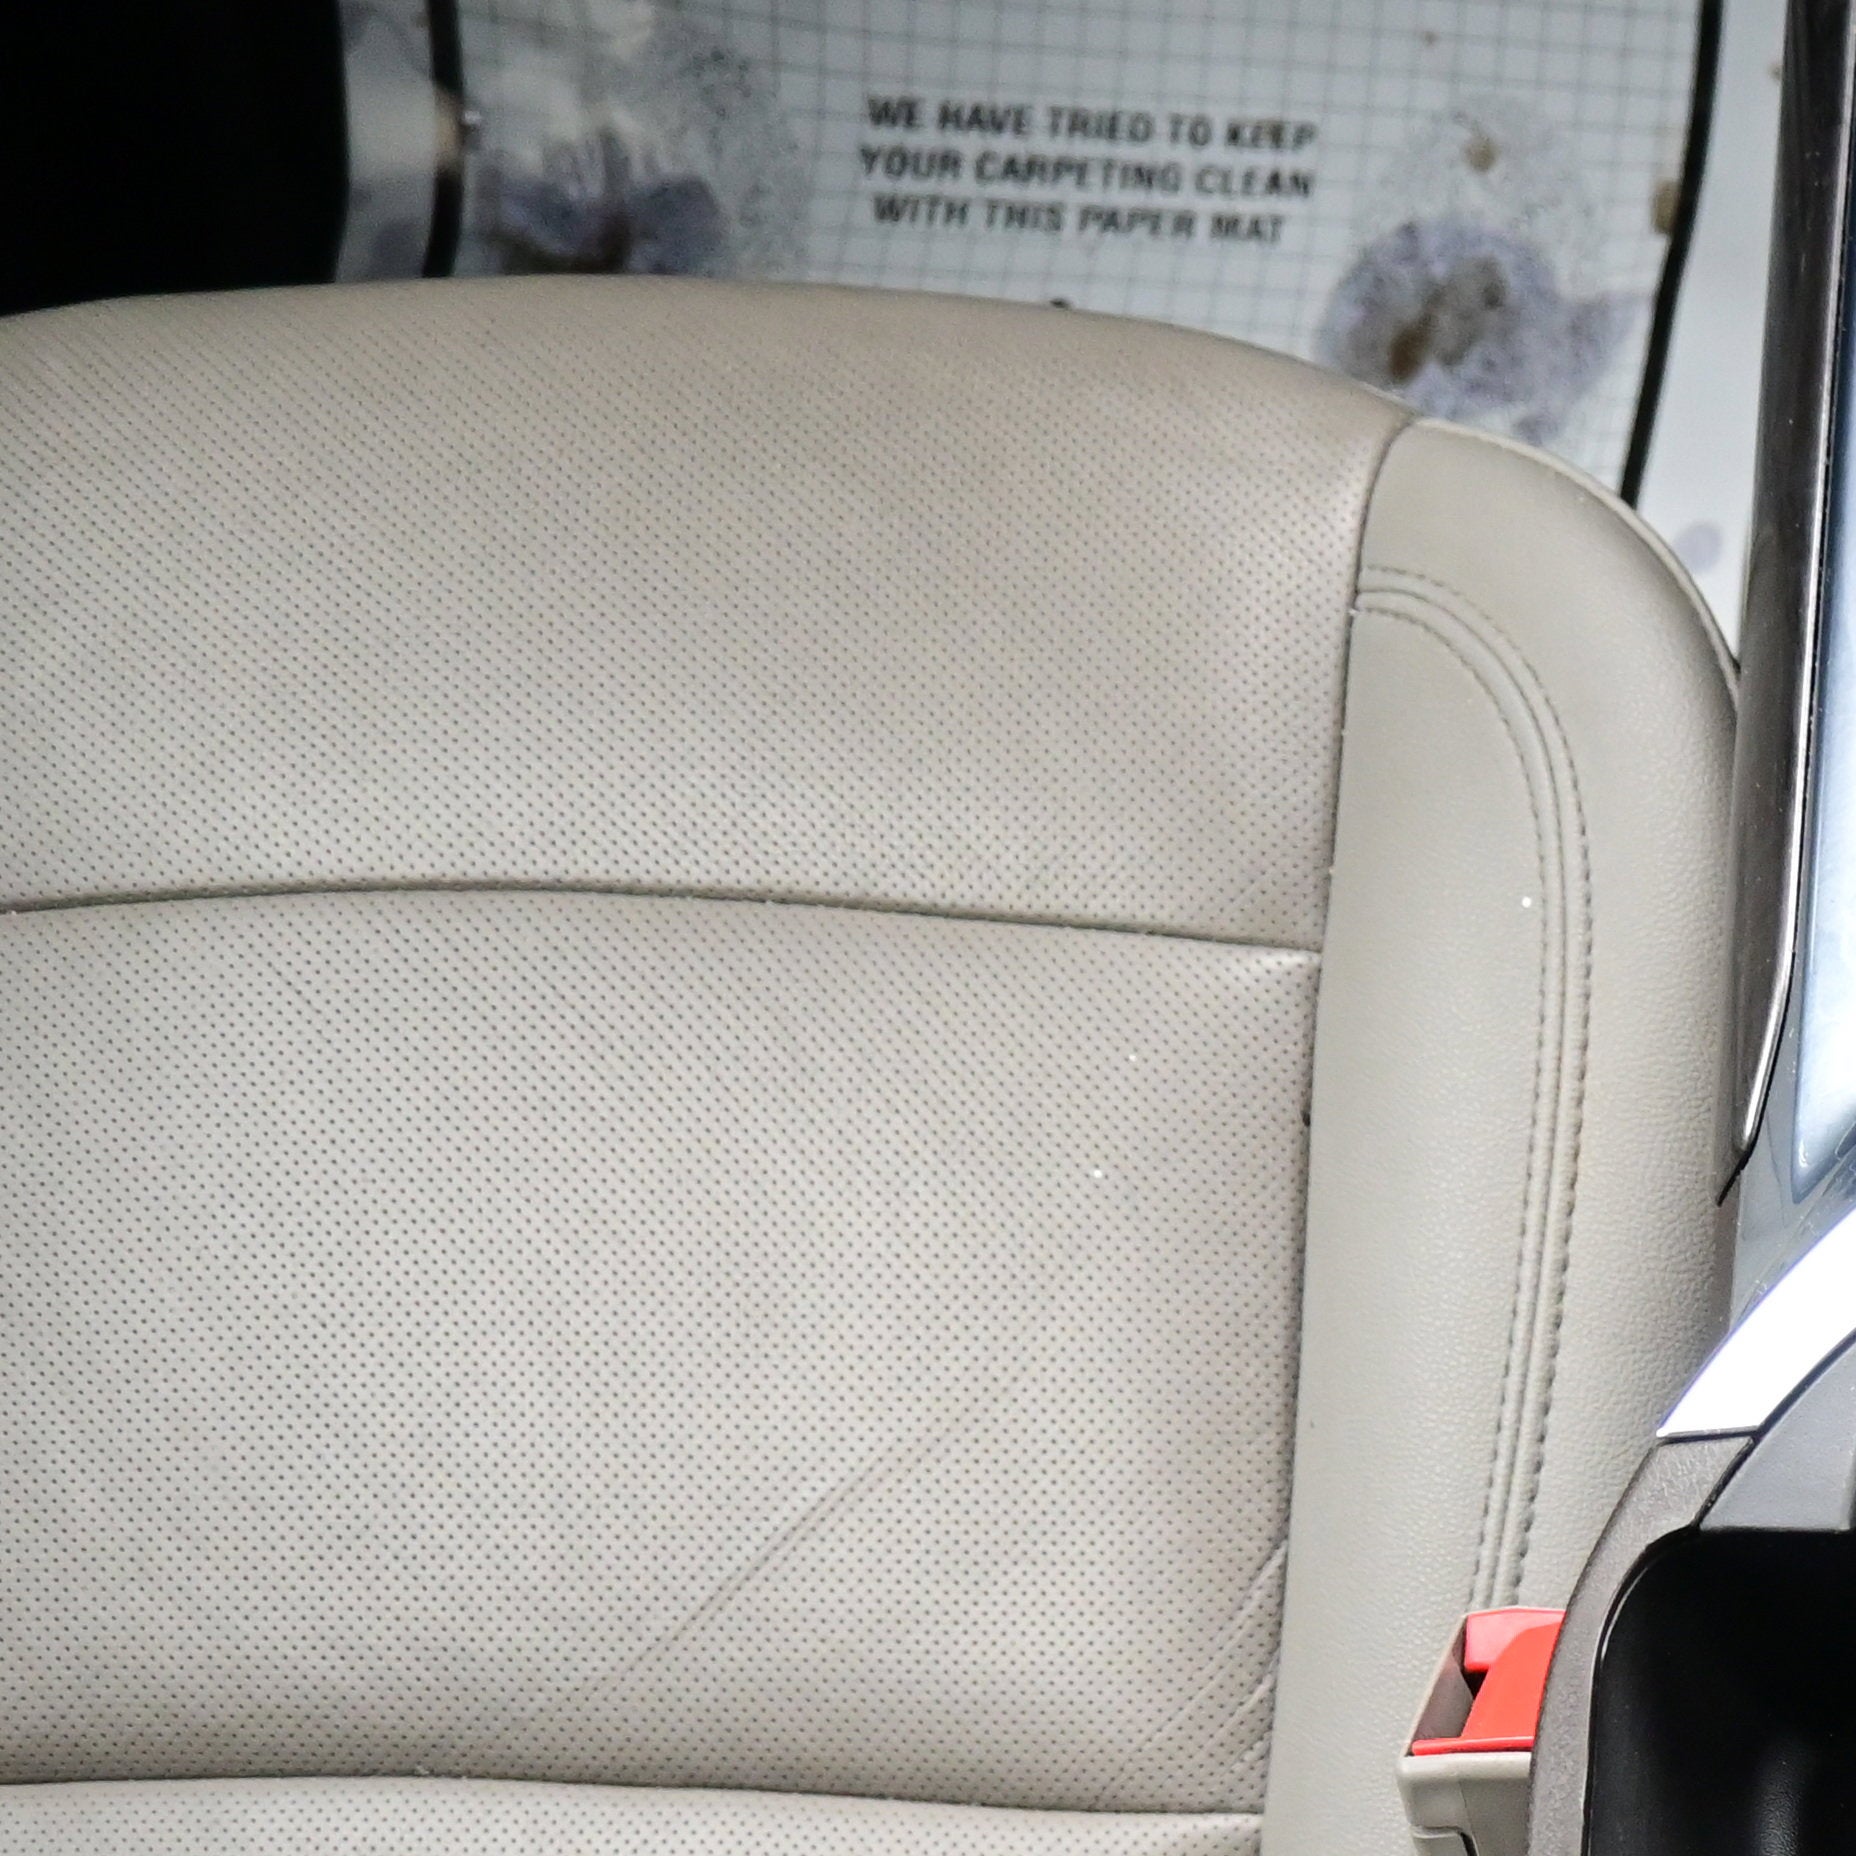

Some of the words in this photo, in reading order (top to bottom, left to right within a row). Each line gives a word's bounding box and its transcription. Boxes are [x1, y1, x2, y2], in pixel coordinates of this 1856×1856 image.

[868, 97, 921, 128] WE
[937, 103, 1029, 135] HAVE
[1049, 107, 1153, 142] TRIED
[1168, 112, 1212, 147] TO
[861, 146, 961, 180] YOUR
[975, 150, 1181, 194] CARPETING
[1196, 164, 1314, 198] CLEAN
[873, 193, 969, 225] WITH
[985, 199, 1063, 232] THIS
[1076, 204, 1196, 240] PAPER
[1209, 211, 1284, 244] MAT
